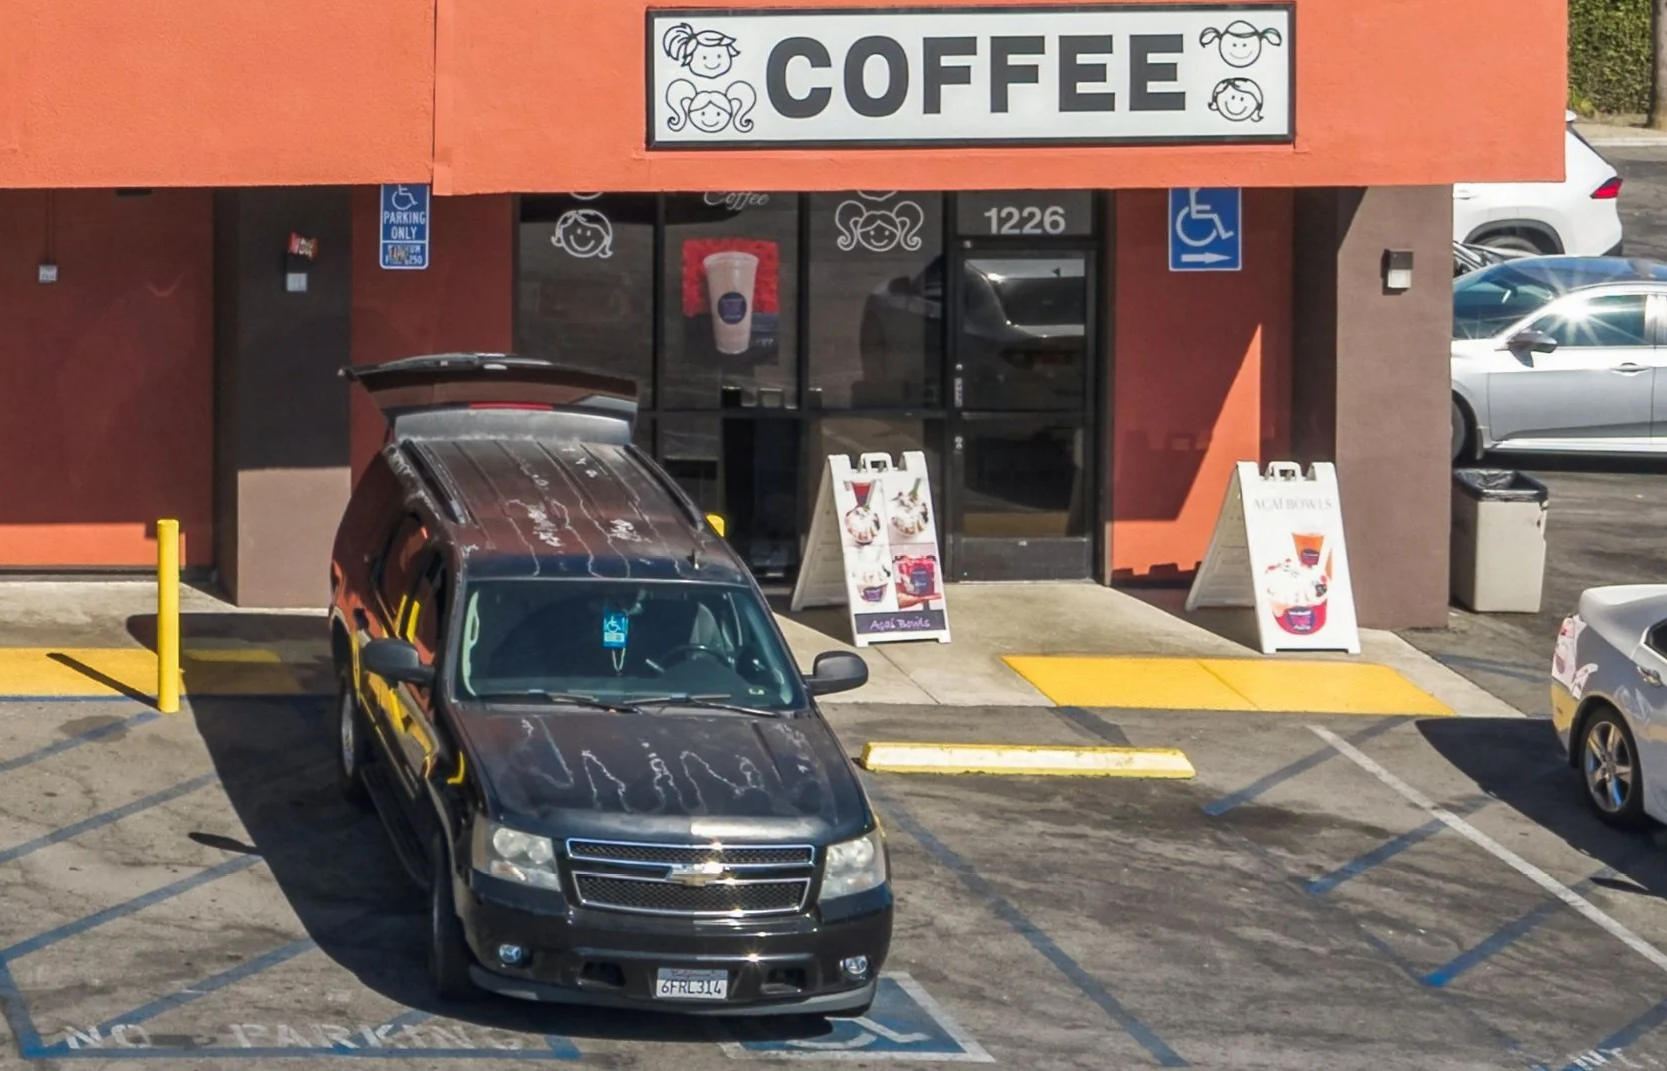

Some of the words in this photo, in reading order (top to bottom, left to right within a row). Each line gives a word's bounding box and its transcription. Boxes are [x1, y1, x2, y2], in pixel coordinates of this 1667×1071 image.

[766, 33, 1187, 119] COFFEE
[383, 211, 426, 225] PARKING
[984, 206, 1066, 235] 1226
[390, 226, 417, 240] ONLY
[63, 1024, 152, 1049] NO
